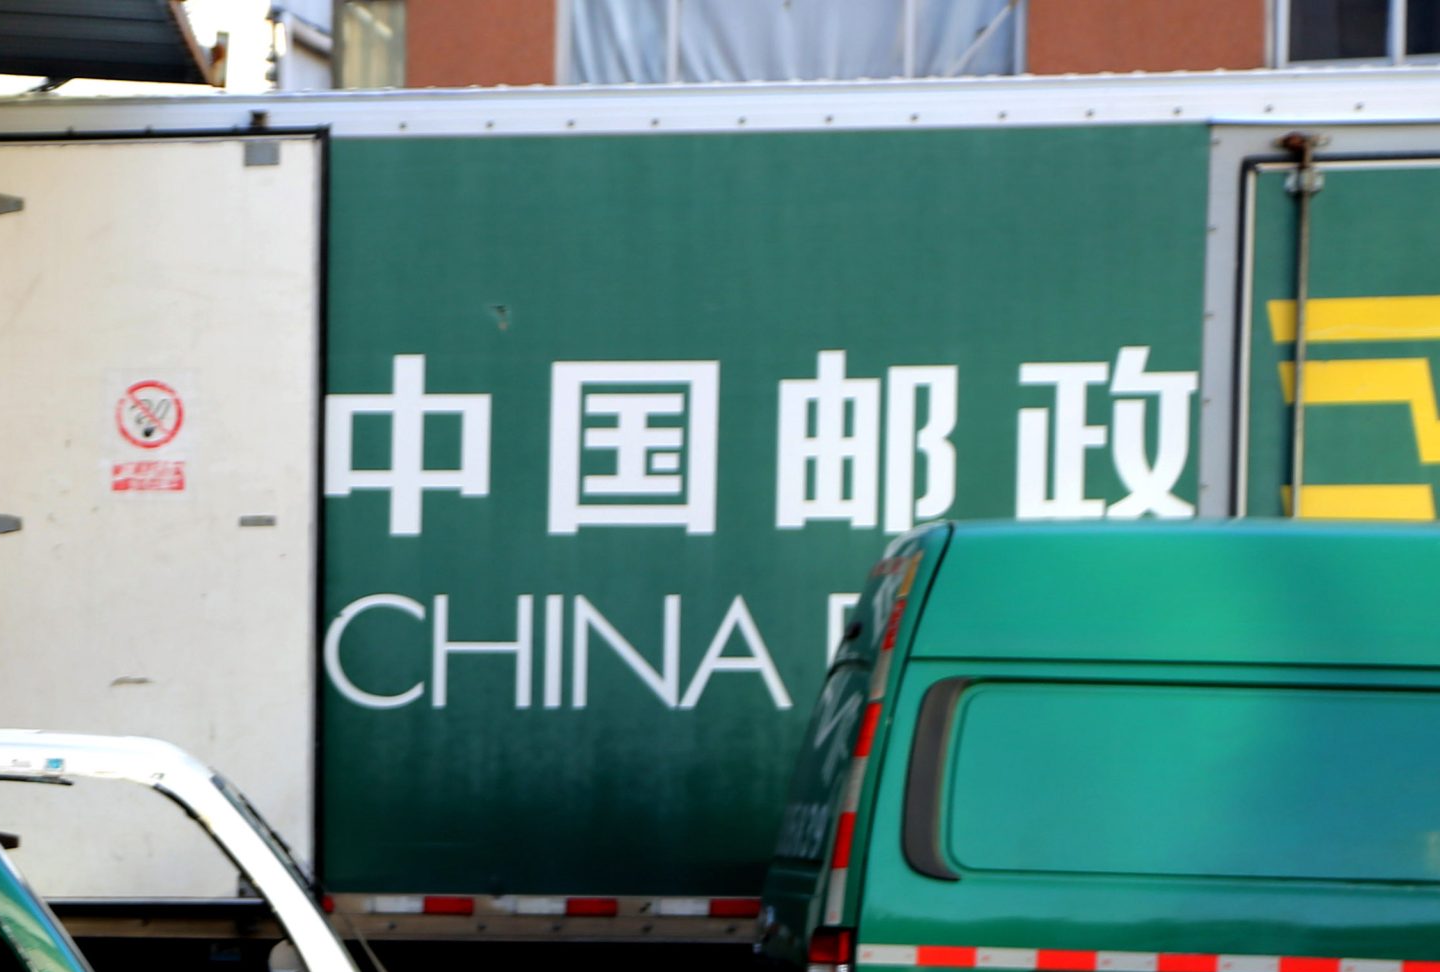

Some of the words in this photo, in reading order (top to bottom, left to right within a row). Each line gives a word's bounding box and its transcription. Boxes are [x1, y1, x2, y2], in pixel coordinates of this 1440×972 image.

[324, 346, 1198, 536] 中国邮政
[324, 593, 792, 710] CHINA
